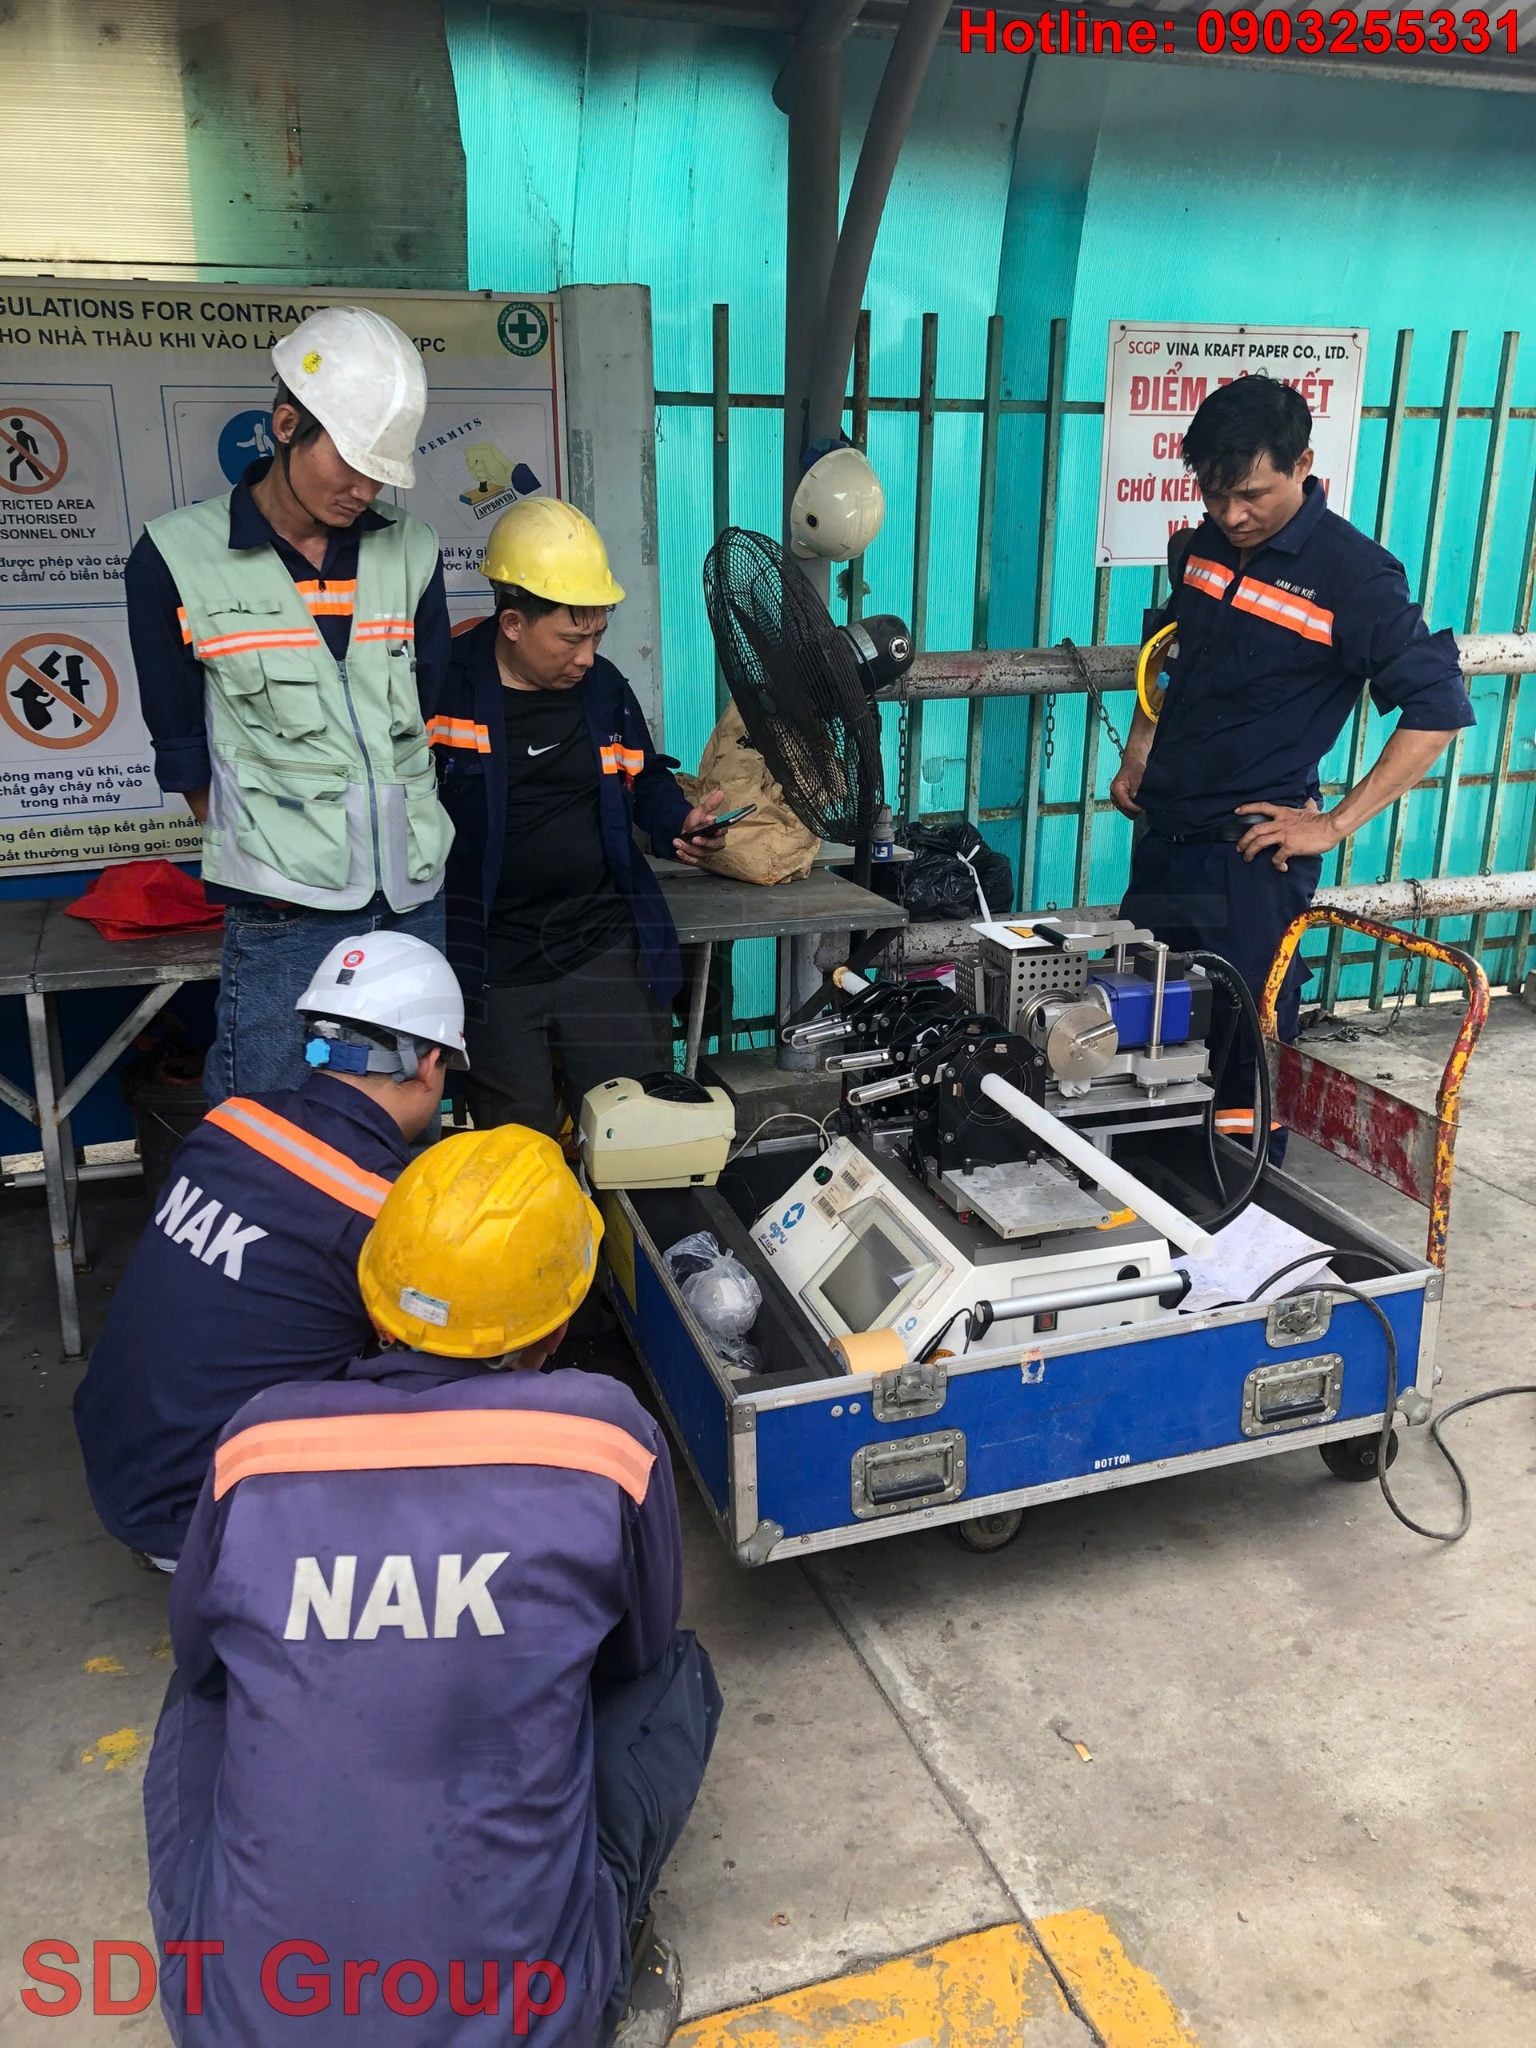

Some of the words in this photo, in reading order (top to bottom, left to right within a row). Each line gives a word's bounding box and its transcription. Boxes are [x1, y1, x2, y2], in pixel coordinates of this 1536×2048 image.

[142, 301, 193, 321] FOR
[39, 326, 87, 345] NHÀ
[92, 328, 152, 347] THẦU
[160, 332, 195, 348] KHI
[202, 330, 247, 349] VÀO
[254, 330, 286, 349] LÀ
[1128, 341, 1160, 355] SCGP
[1166, 342, 1199, 356] VINA
[1204, 343, 1245, 358] KRAFT
[1249, 344, 1288, 359] PAPER
[1293, 345, 1320, 361] CO.,
[1325, 346, 1349, 360] LTD.
[1130, 361, 1207, 411] ĐIỂM
[418, 418, 483, 455] PERMITS
[1117, 473, 1156, 502] CHỜ
[0, 499, 53, 510] RICTED
[57, 499, 95, 510] AREA
[478, 490, 514, 516] APPROVED
[60, 528, 96, 538] ONLY
[40, 556, 73, 569] phép
[76, 555, 101, 566] vào
[49, 570, 66, 581] có
[34, 769, 73, 780] mang
[77, 767, 94, 777] vũ
[98, 765, 122, 776] khí,
[127, 764, 150, 774] các
[30, 783, 55, 796] gây
[59, 780, 92, 793] cháy
[118, 778, 142, 787] vào
[20, 798, 59, 809] trong
[63, 794, 88, 805] nhà
[92, 793, 121, 804] máy
[19, 827, 45, 840] đến
[88, 825, 110, 836] tập
[115, 821, 136, 833] kết
[83, 845, 104, 855] vui
[109, 843, 140, 853] lòng
[154, 1176, 270, 1281] NAK
[283, 1552, 511, 1641] NAK
